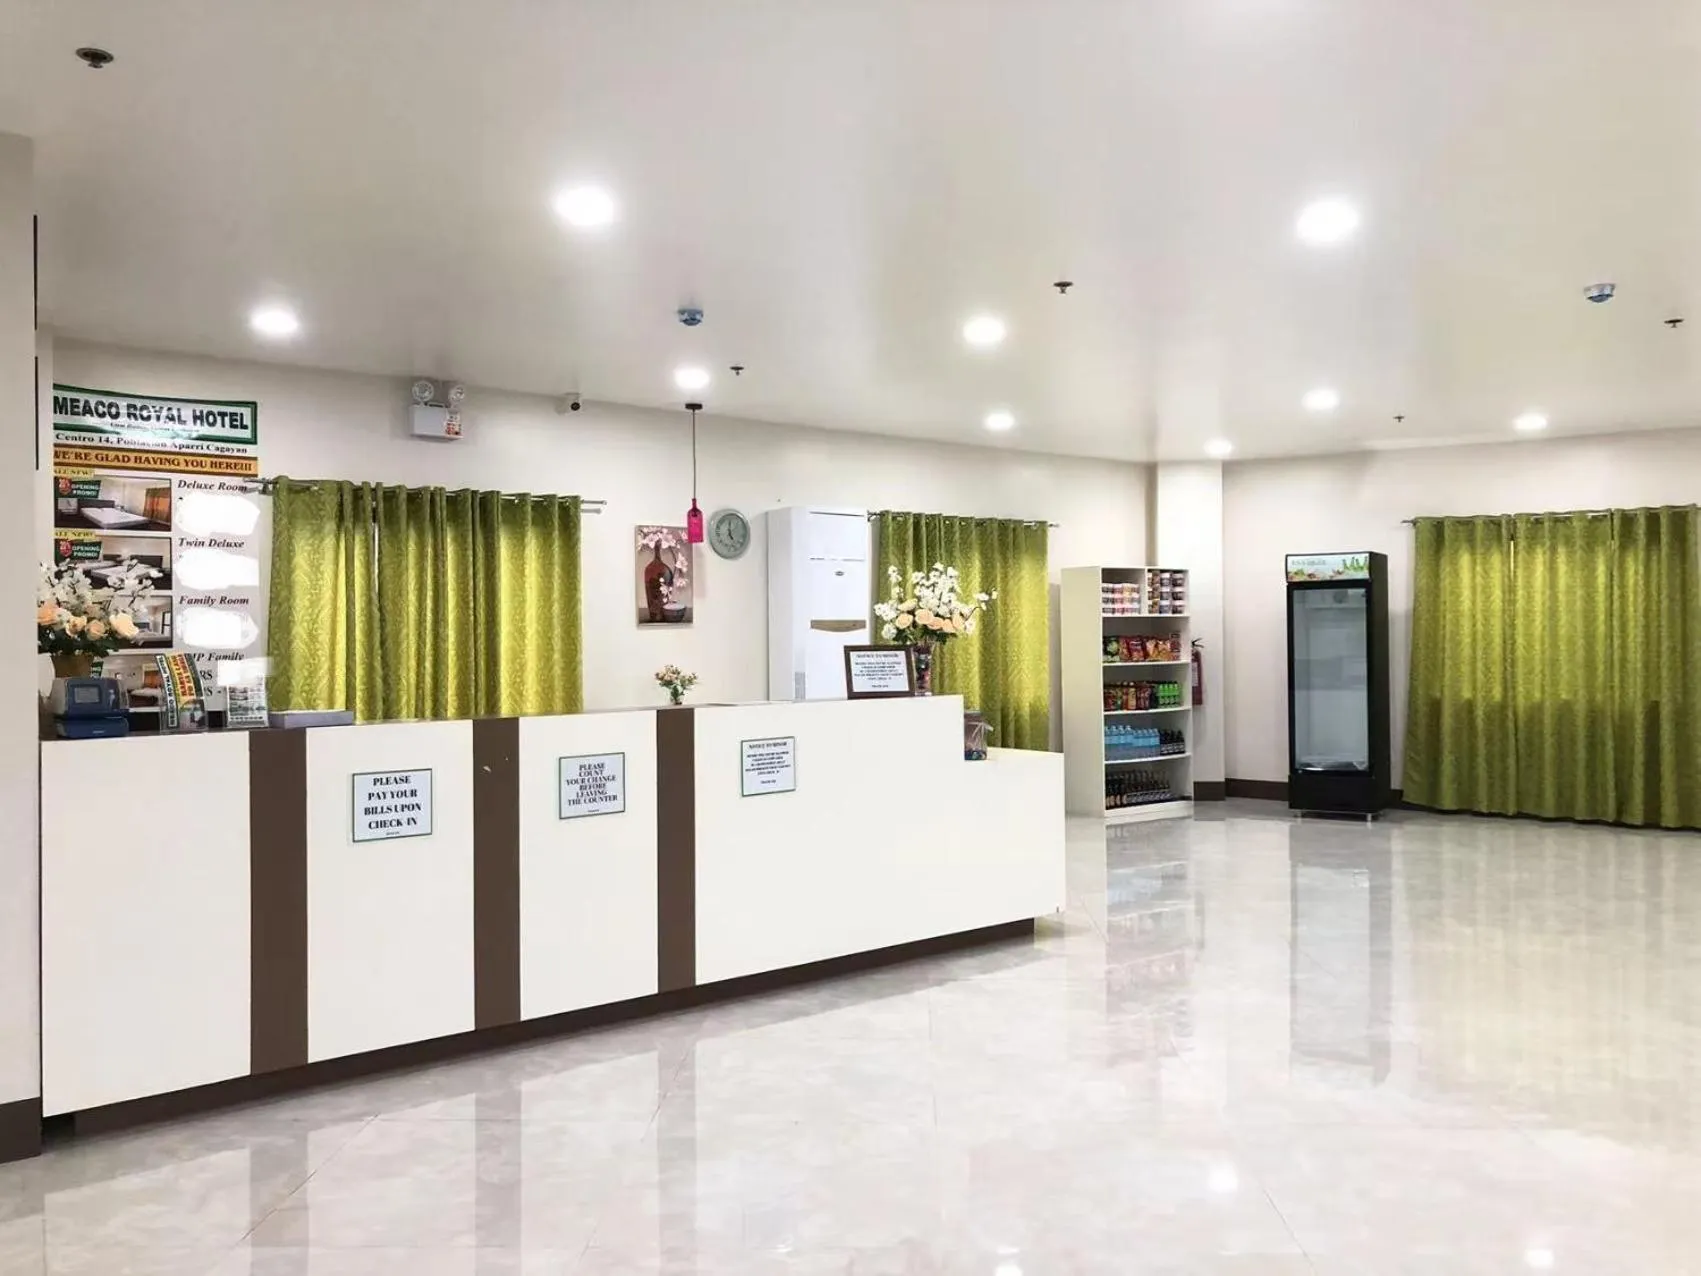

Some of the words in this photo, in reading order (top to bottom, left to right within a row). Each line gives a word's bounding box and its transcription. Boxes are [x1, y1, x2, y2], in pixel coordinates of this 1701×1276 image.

[53, 395, 121, 420] MEACO
[127, 402, 187, 425] ROYAL
[192, 409, 249, 430] HOTEL
[55, 433, 95, 443] Centro
[206, 444, 248, 454] Cagayan
[95, 453, 131, 463] GLAD
[134, 455, 180, 466] HAVING
[184, 458, 207, 469] YOU
[209, 460, 252, 471] HERE!!!
[177, 480, 215, 490] Deluxe
[218, 482, 248, 492] Room
[179, 538, 205, 547] Twin
[208, 538, 245, 548] Deluxe
[179, 595, 216, 608] Family
[219, 596, 249, 605] Room
[579, 762, 605, 771] PLEASE
[579, 769, 604, 777] COUNT
[373, 775, 412, 786] PLEASE
[566, 777, 586, 786] YOUR
[587, 774, 616, 783] CHANGE
[579, 783, 606, 791] BEFORE
[368, 791, 387, 801] PAY
[390, 789, 418, 799] YOUR
[576, 789, 608, 798] LEAVING
[583, 794, 618, 804] COUNTER
[364, 805, 393, 816] BILLS
[394, 803, 422, 813] UPON
